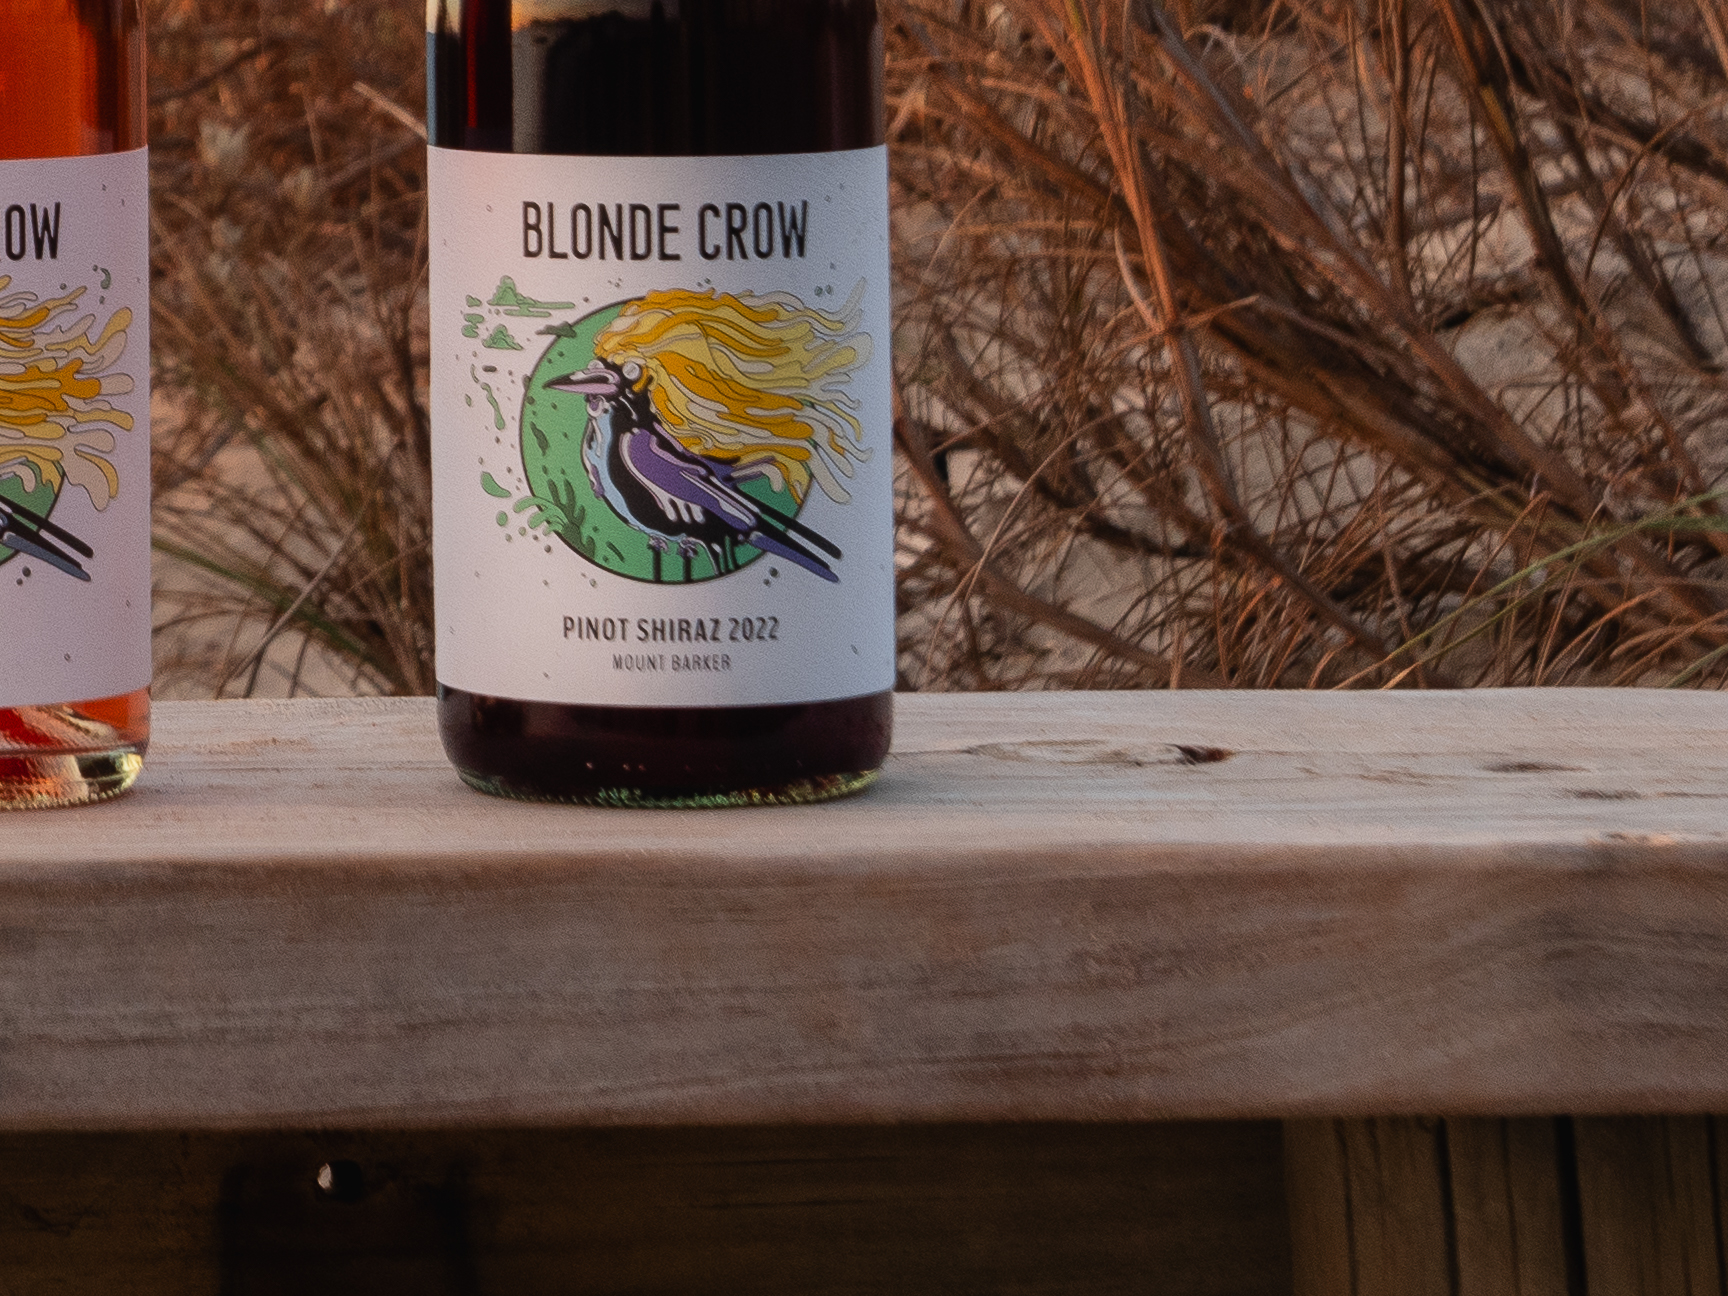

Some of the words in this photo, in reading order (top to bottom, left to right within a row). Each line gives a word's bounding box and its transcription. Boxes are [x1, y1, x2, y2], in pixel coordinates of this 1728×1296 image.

[523, 201, 682, 262] BLONDE
[698, 200, 808, 261] CROW
[563, 616, 629, 642] PINOT
[637, 617, 721, 643] SHIRAZ
[729, 615, 779, 642] 2022
[613, 654, 665, 672] MOUNT
[671, 653, 732, 672] BARKER
